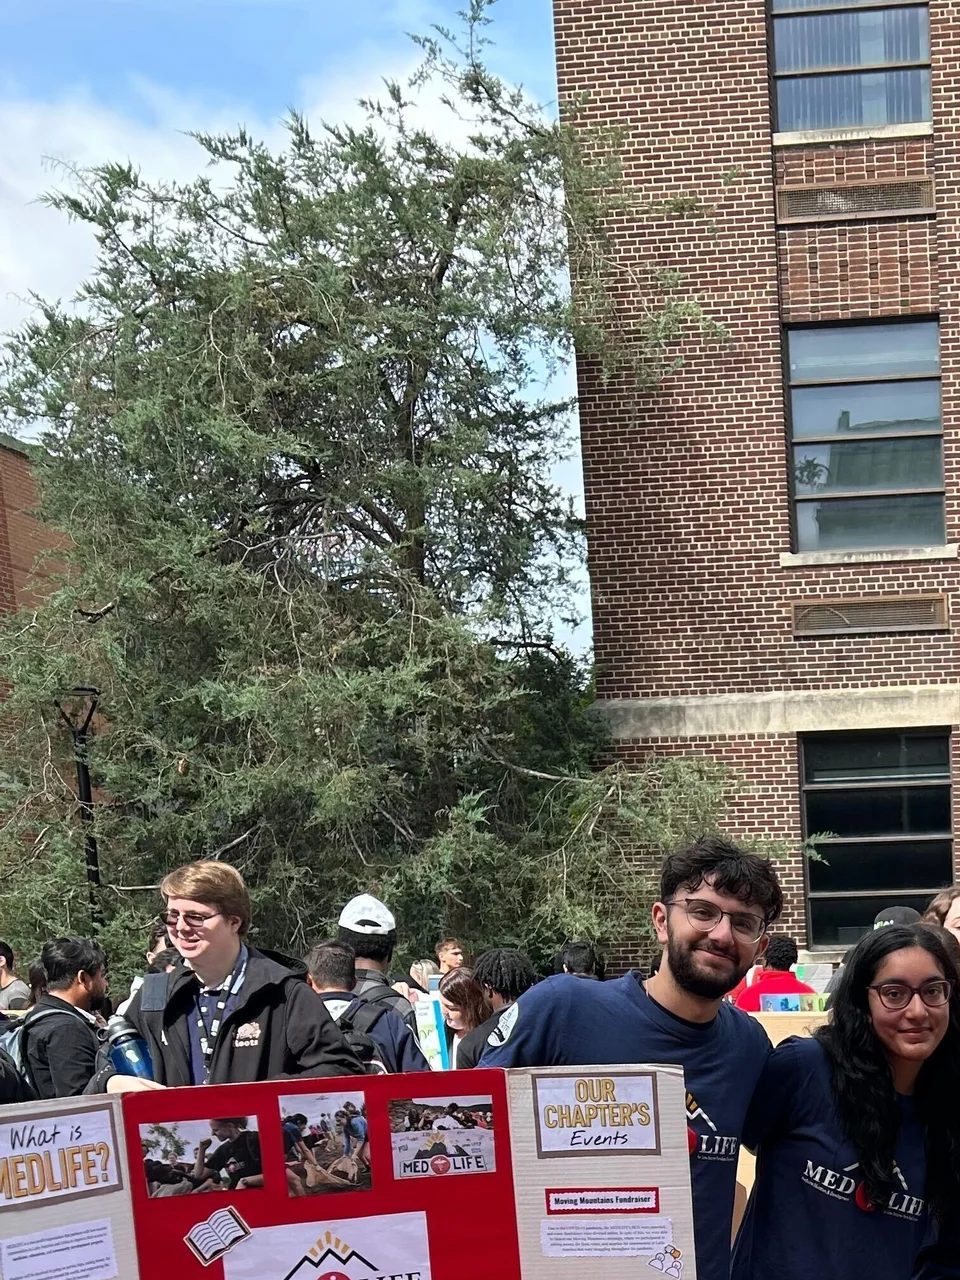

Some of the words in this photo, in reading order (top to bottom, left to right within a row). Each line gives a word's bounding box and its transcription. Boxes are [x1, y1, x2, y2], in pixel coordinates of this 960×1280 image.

[574, 1078, 616, 1102] OUR
[544, 1104, 652, 1130] CHAPTER'S
[10, 1124, 61, 1150] What
[69, 1125, 83, 1142] is
[570, 1129, 629, 1147] Events
[698, 1134, 738, 1155] LIFE
[403, 1160, 429, 1174] MED
[452, 1155, 485, 1170] LIFE
[802, 1159, 856, 1195] MED
[554, 1197, 578, 1206] Moving
[579, 1196, 614, 1205] Mountains
[615, 1195, 651, 1204] Fundraiser
